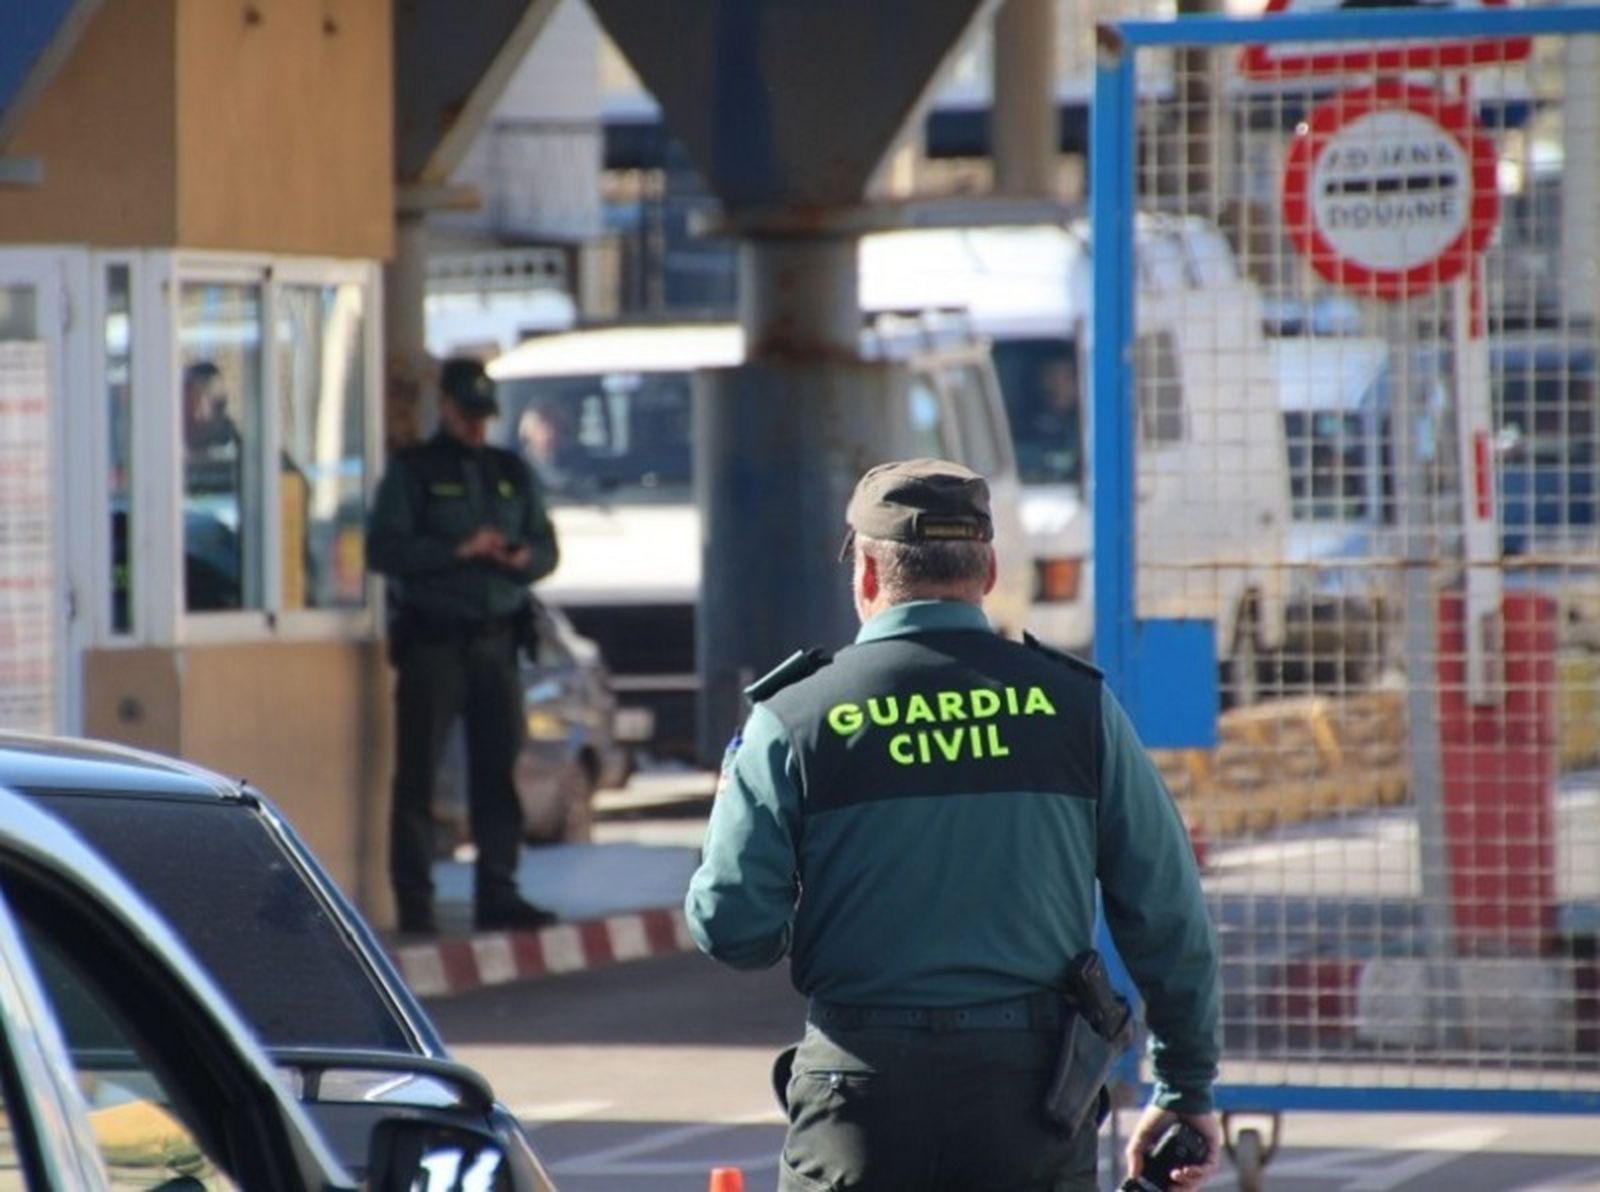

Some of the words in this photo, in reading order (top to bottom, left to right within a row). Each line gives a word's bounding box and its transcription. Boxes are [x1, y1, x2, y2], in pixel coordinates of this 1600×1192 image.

[1327, 196, 1455, 229] DOUANE
[828, 686, 1057, 736] GUARDIA
[888, 724, 1010, 765] CIVIL
